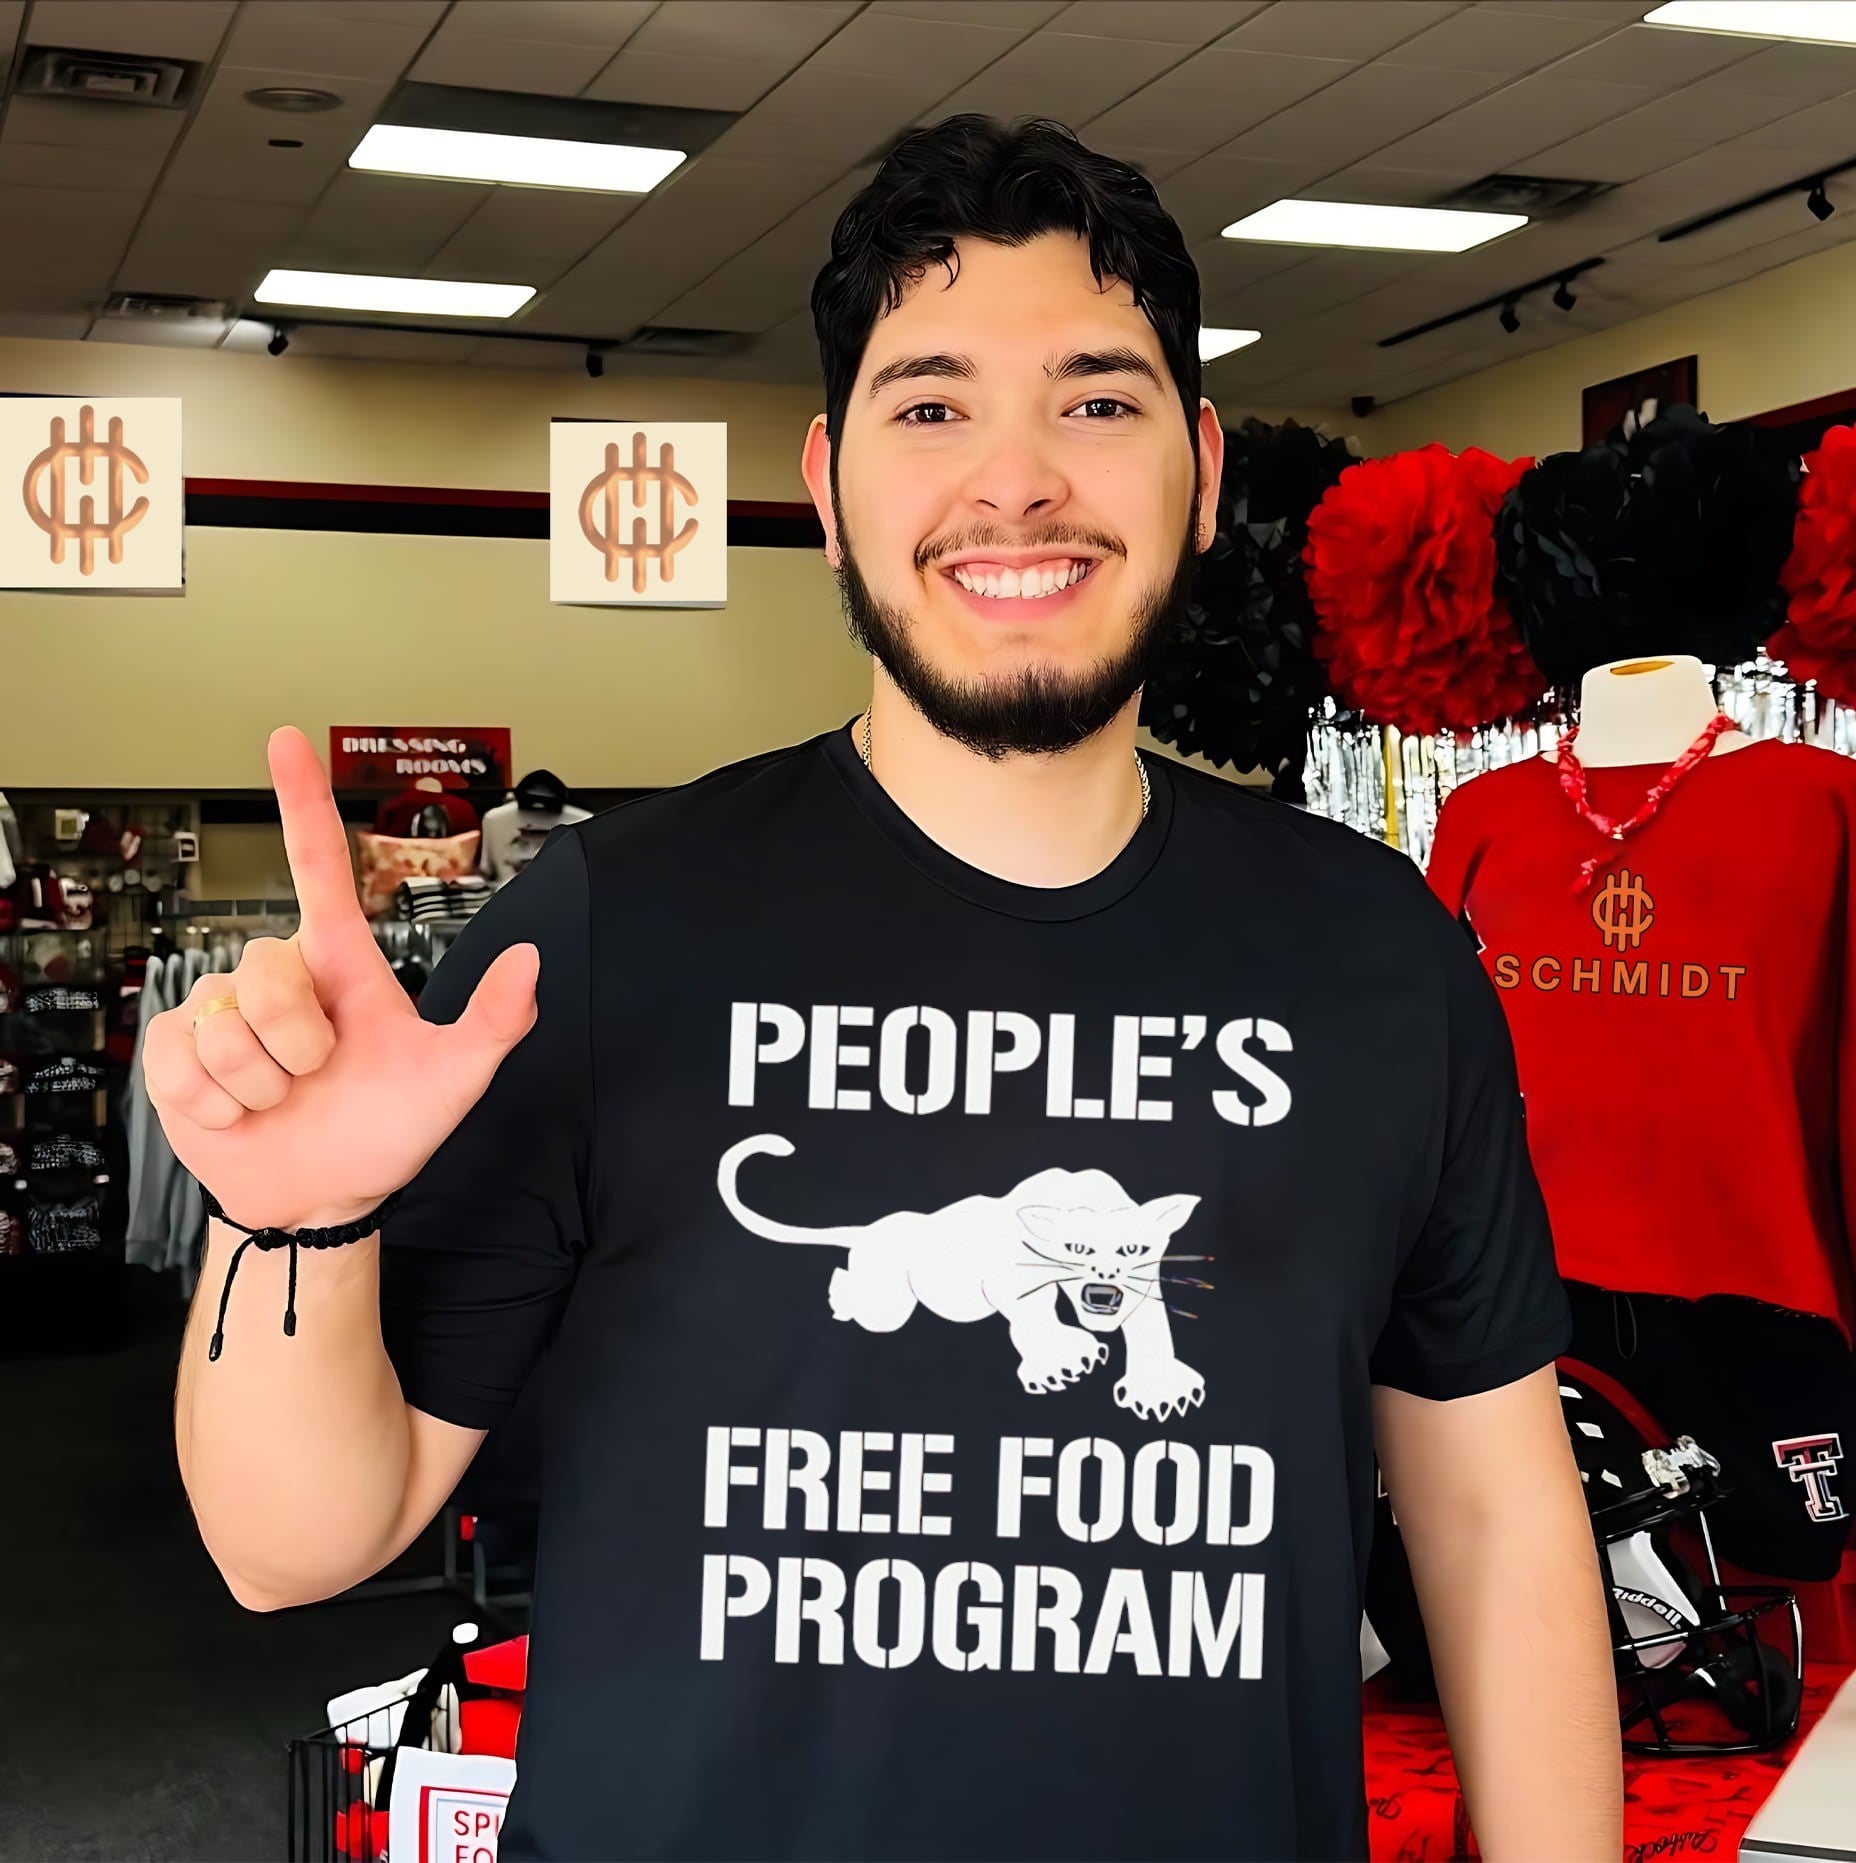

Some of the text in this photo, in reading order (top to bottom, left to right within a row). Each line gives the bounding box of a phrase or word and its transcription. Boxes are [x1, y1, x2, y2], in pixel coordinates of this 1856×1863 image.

[396, 758, 487, 775] ROOMS
[1494, 954, 1746, 999] SCHMIDT
[728, 1001, 1294, 1127] PEOPLE'S
[703, 1426, 1275, 1546] FREE FOOD
[700, 1554, 1266, 1680] PROGRAM
